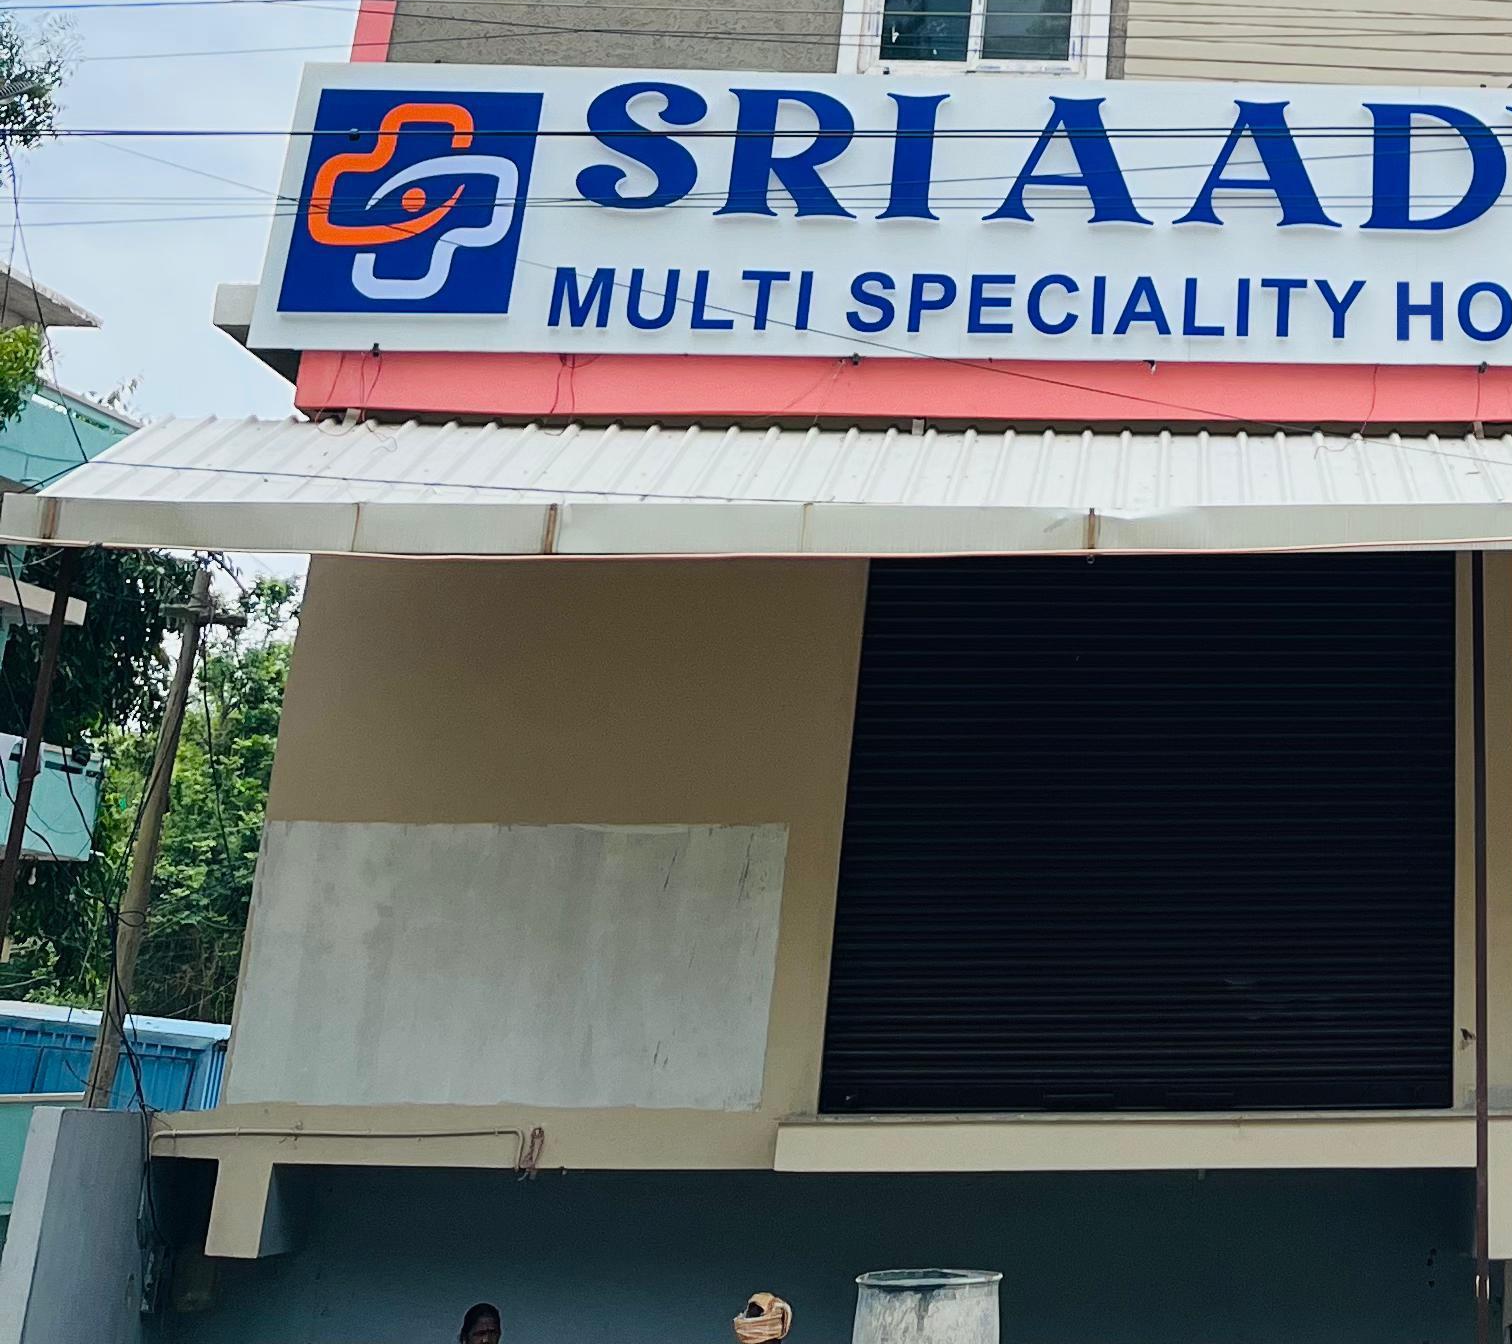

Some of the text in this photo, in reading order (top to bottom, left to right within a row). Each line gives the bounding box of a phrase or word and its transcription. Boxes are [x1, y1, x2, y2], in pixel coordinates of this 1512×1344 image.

[575, 81, 950, 221] SRI
[547, 266, 812, 331] MULTI
[845, 271, 1366, 338] SPECIALITY
